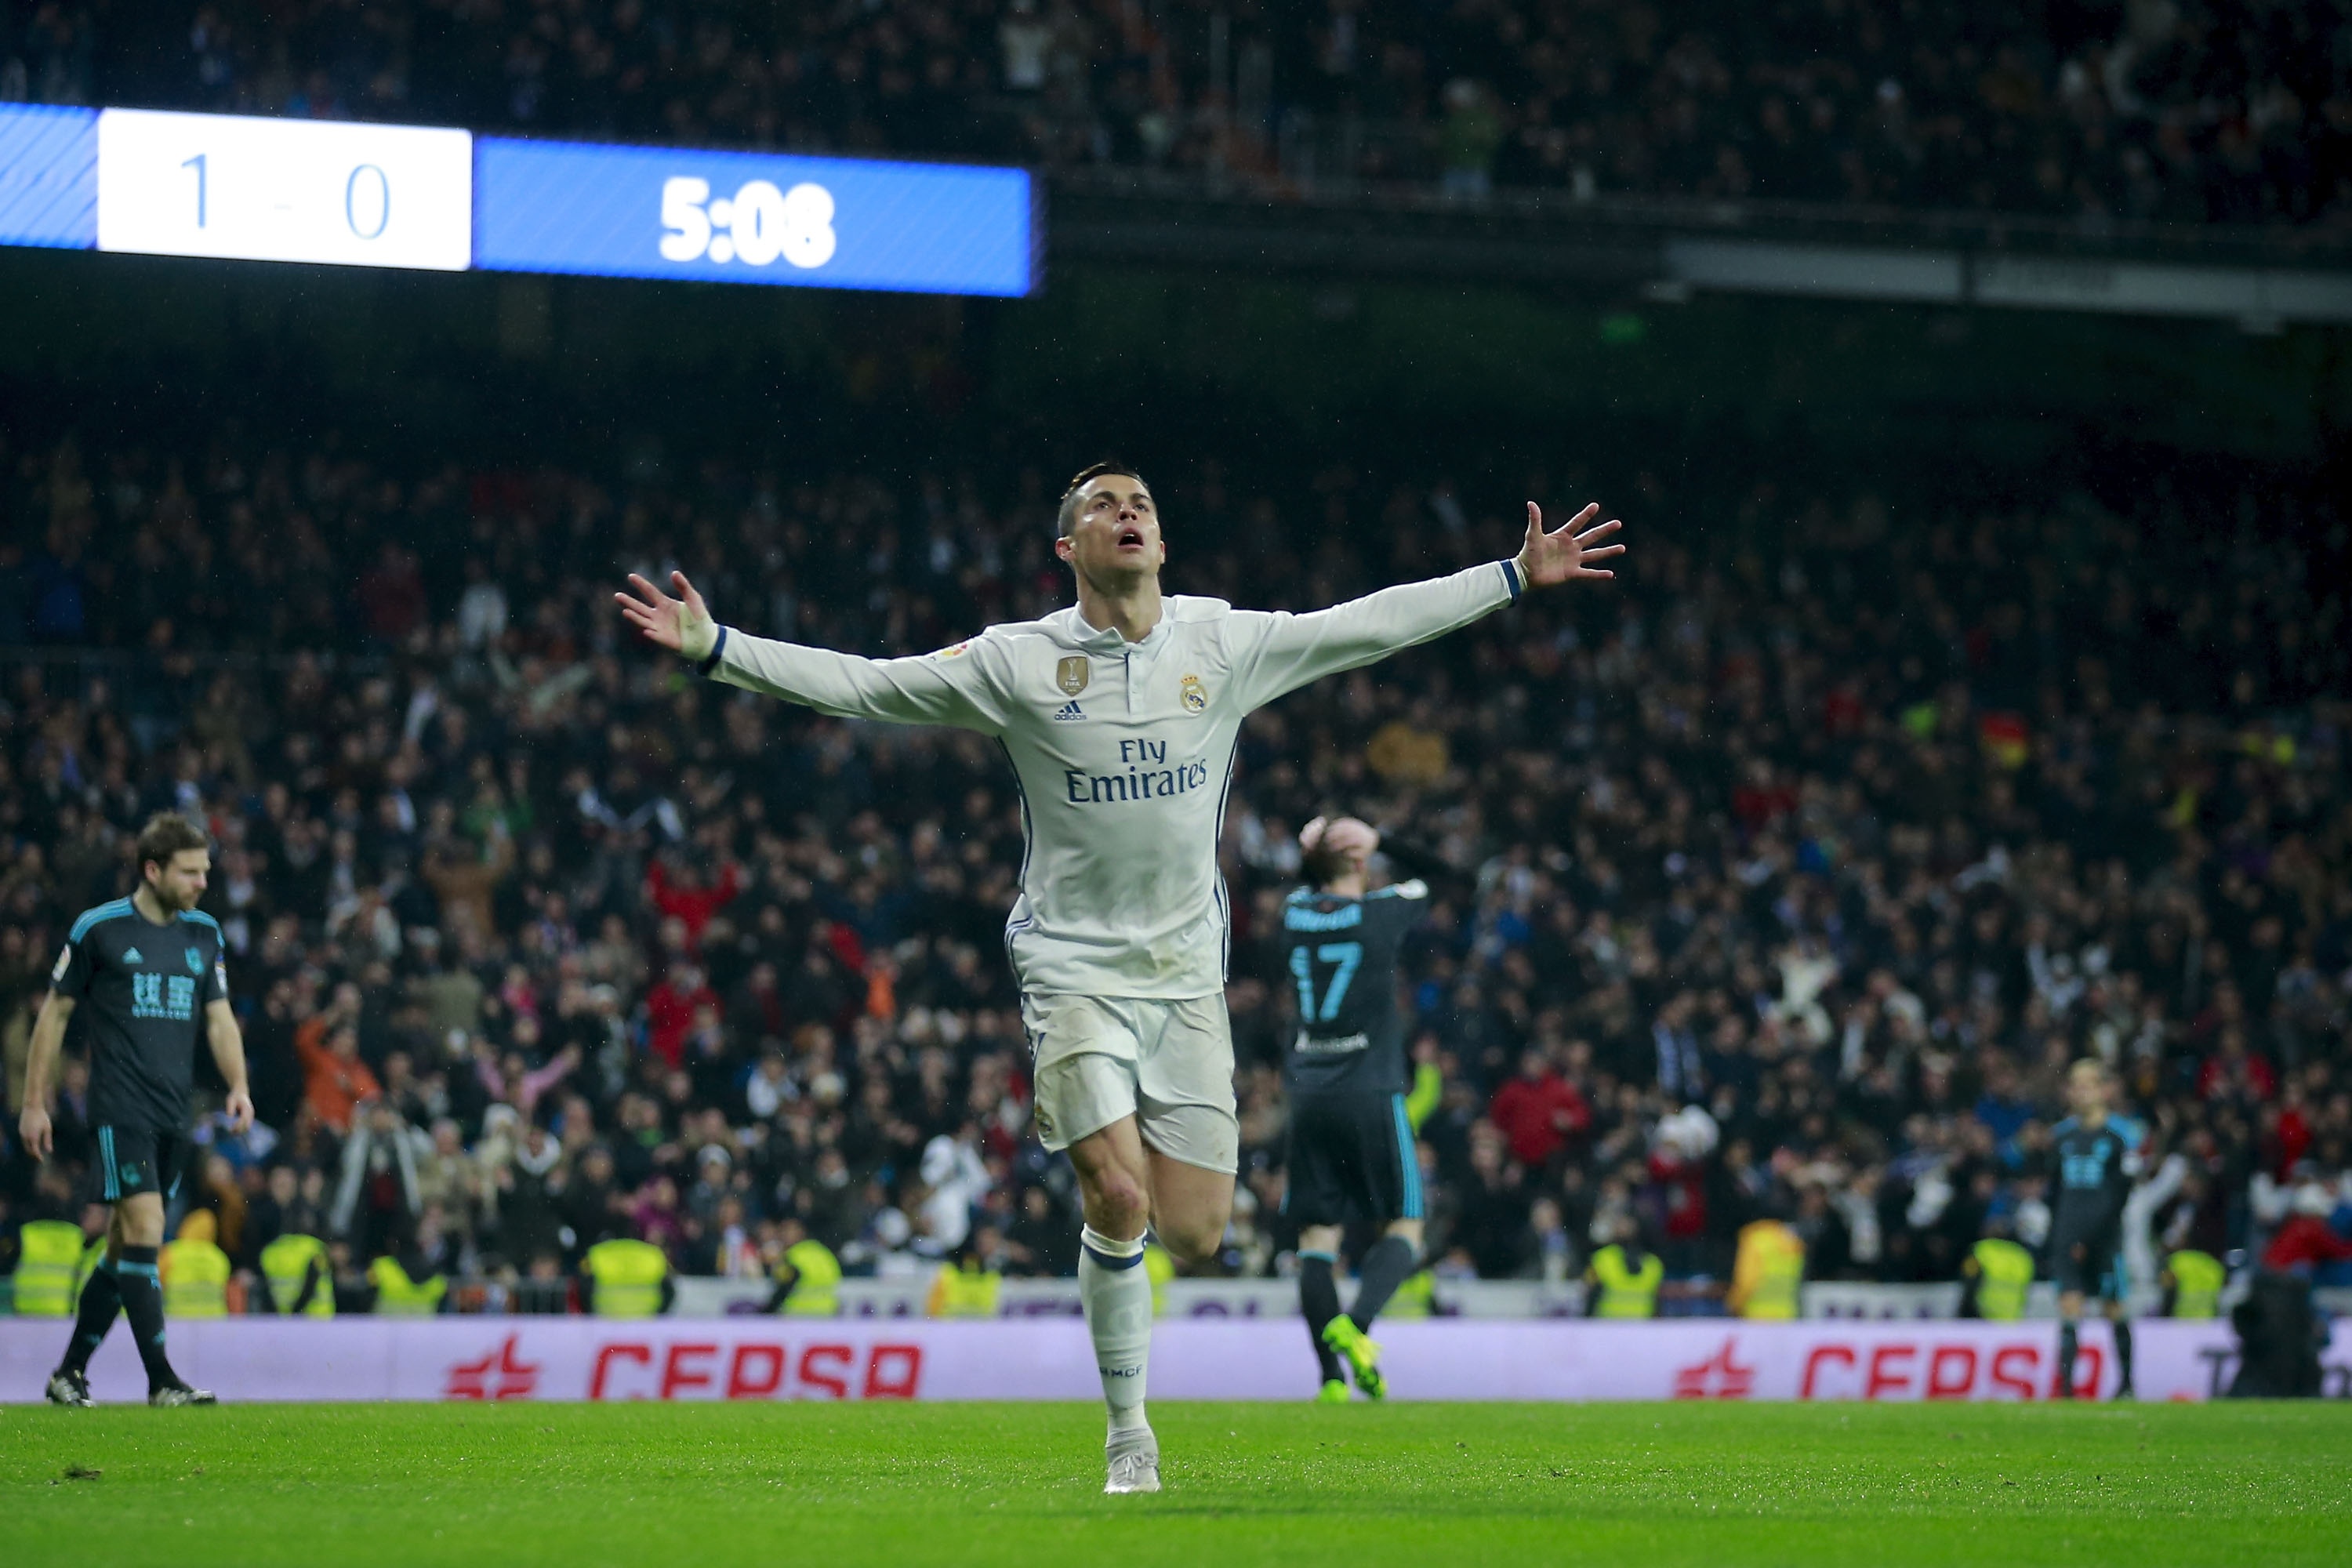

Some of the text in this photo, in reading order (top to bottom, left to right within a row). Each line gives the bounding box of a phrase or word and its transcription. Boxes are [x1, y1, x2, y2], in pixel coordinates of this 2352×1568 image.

[181, 154, 206, 229] 1
[344, 164, 390, 240] 0
[659, 176, 837, 269] 5:08
[1065, 758, 1207, 803] Emirates
[1119, 739, 1166, 764] Fly
[1289, 942, 1363, 1023] 17
